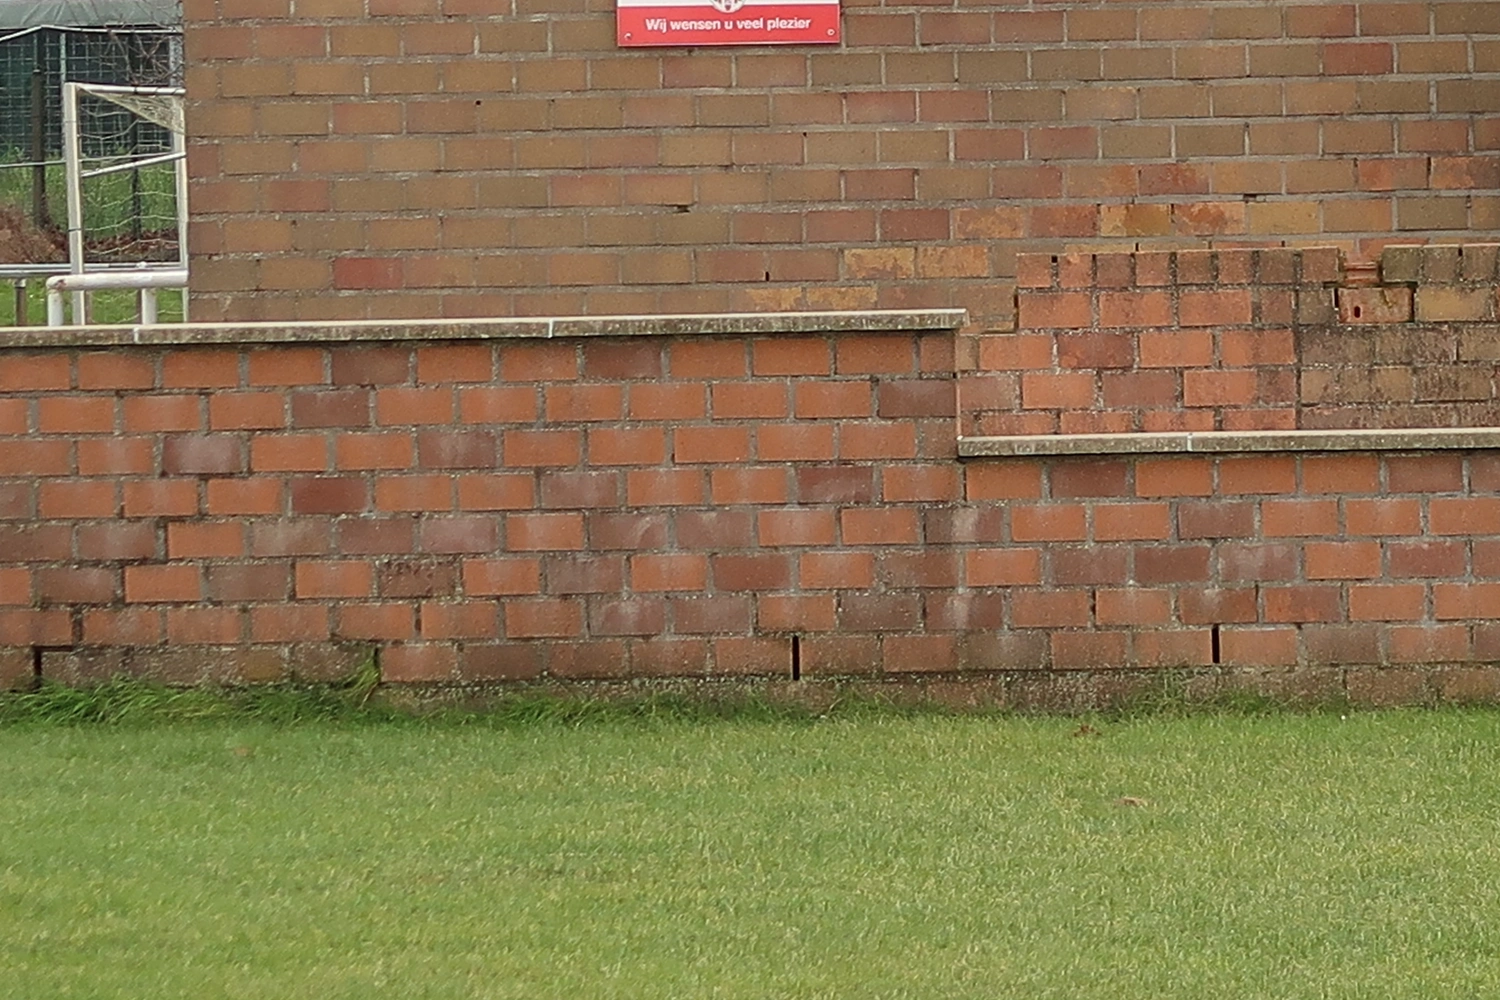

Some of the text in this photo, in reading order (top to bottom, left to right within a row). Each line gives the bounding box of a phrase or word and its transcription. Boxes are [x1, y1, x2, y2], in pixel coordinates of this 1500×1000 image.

[645, 16, 812, 33] Wij wensen u veel plezier
